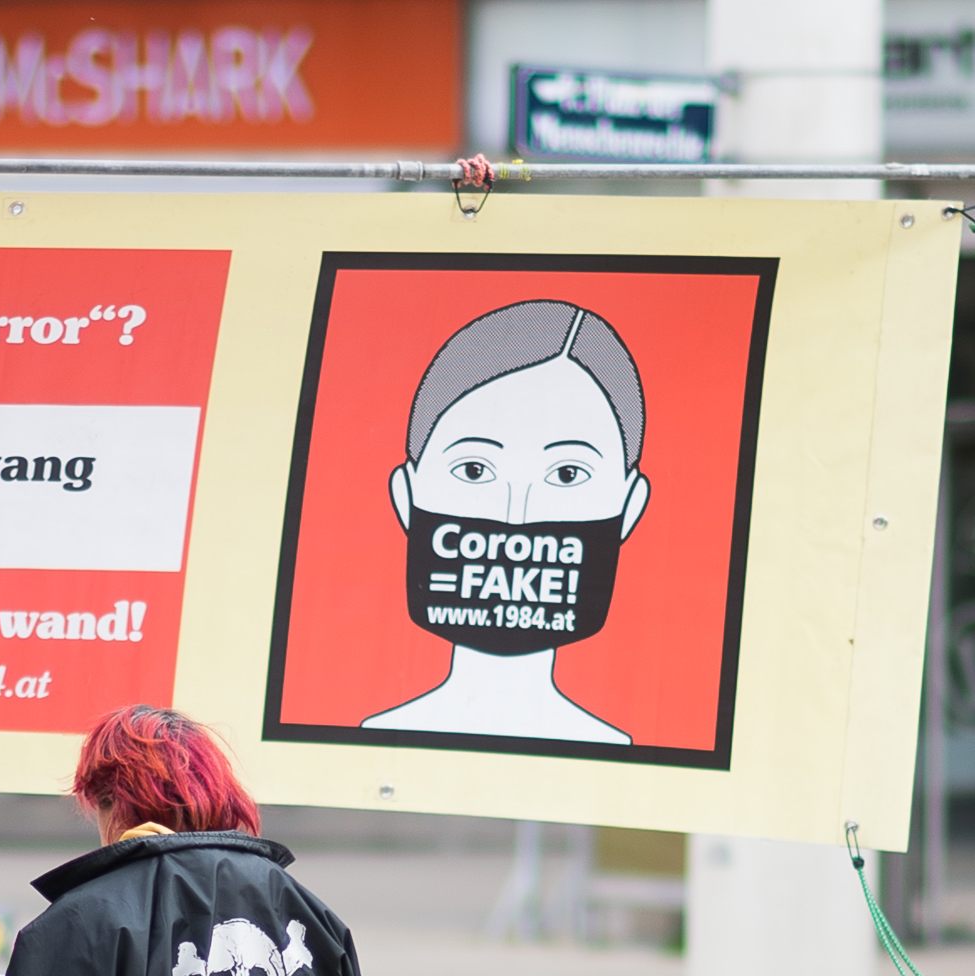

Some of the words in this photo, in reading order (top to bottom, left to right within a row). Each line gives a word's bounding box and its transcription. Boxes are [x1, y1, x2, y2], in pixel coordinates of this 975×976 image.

[432, 523, 584, 564] Corona
[429, 564, 580, 604] =FAKE!
[426, 604, 576, 632] www.1984.at
